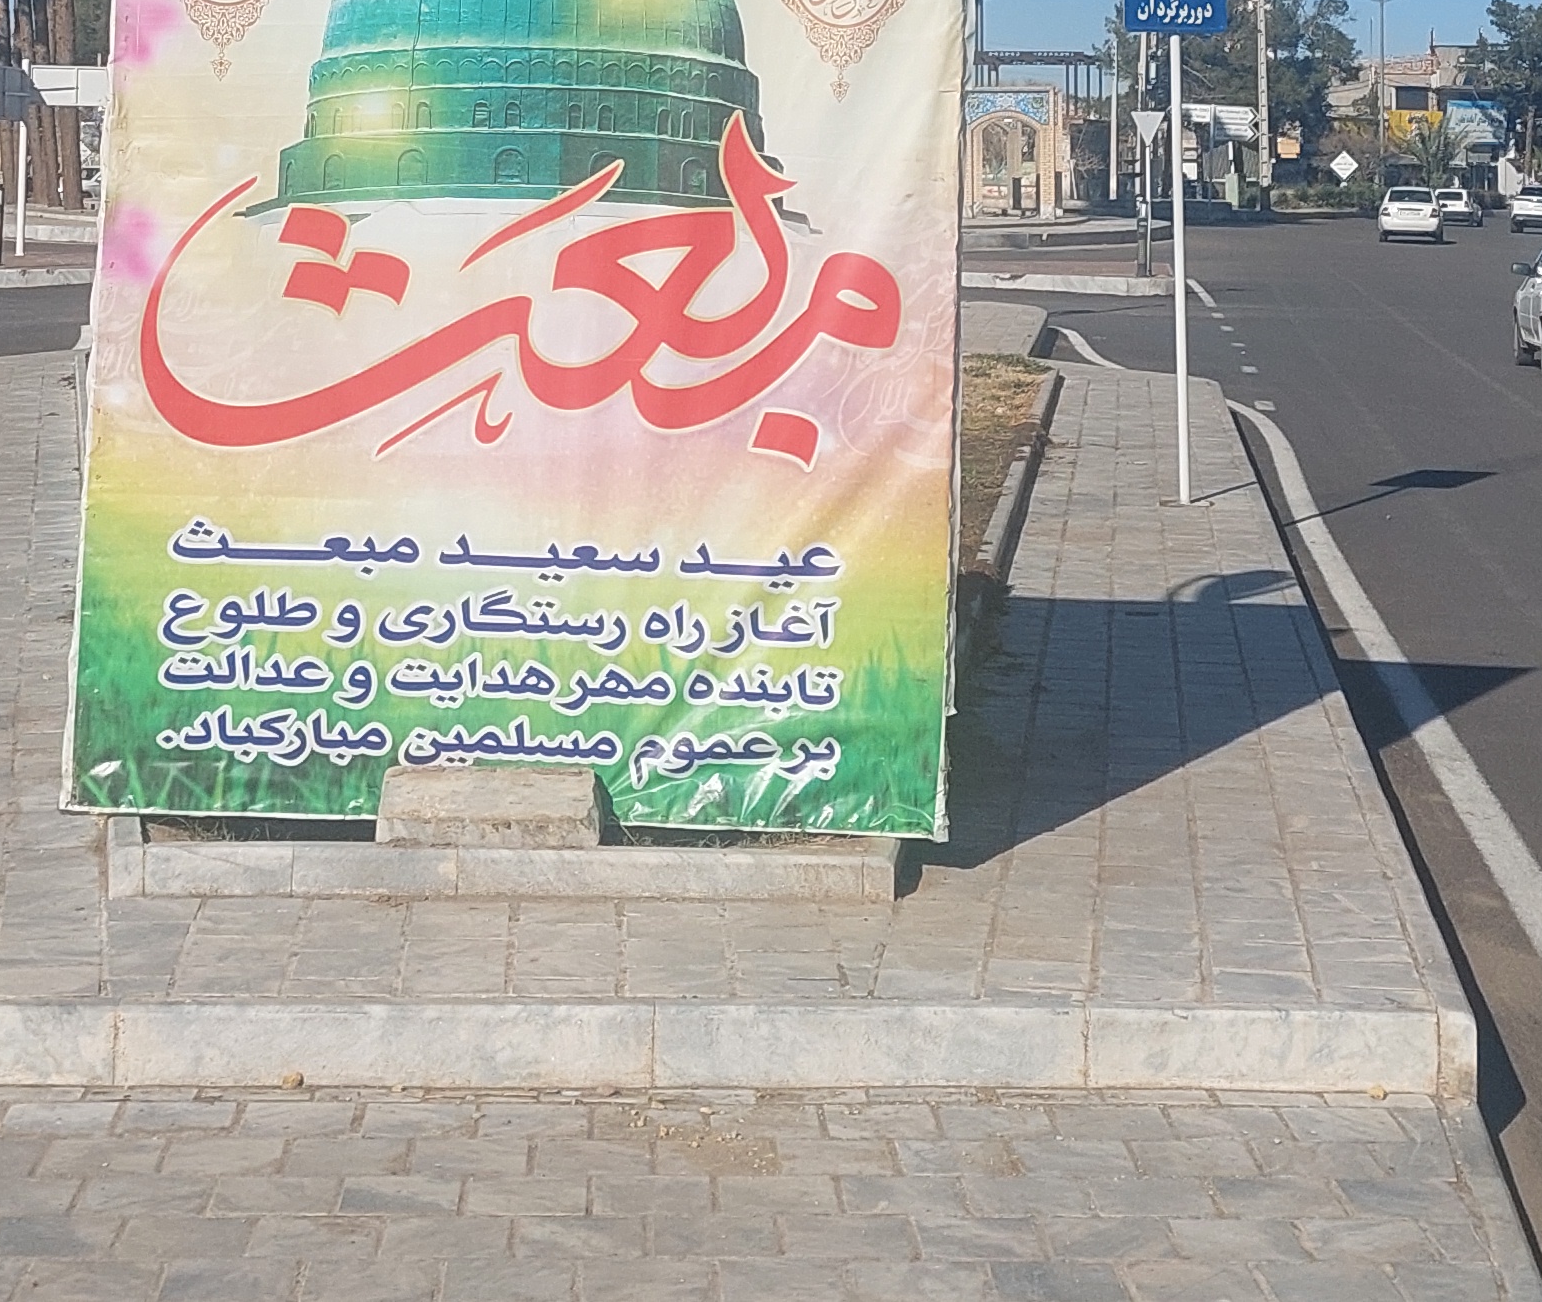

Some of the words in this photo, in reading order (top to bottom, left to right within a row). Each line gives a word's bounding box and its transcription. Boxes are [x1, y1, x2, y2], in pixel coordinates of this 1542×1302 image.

[139, 110, 902, 473] مبعث
[171, 520, 421, 575] مبعث
[439, 533, 661, 583] سعید
[679, 542, 841, 589] عید
[162, 590, 318, 645] طلوع
[327, 603, 362, 643] و
[378, 589, 627, 651] رستگاری
[644, 603, 706, 654] راه
[712, 600, 838, 654] آغاز
[163, 649, 329, 689] عدالت
[338, 664, 372, 705] و
[390, 658, 555, 704] هدایت
[557, 668, 672, 711] مهر
[688, 668, 839, 714] تابنده
[160, 709, 388, 762] مبارکباد.
[402, 720, 618, 765] مسلمین
[632, 737, 779, 785] عموم
